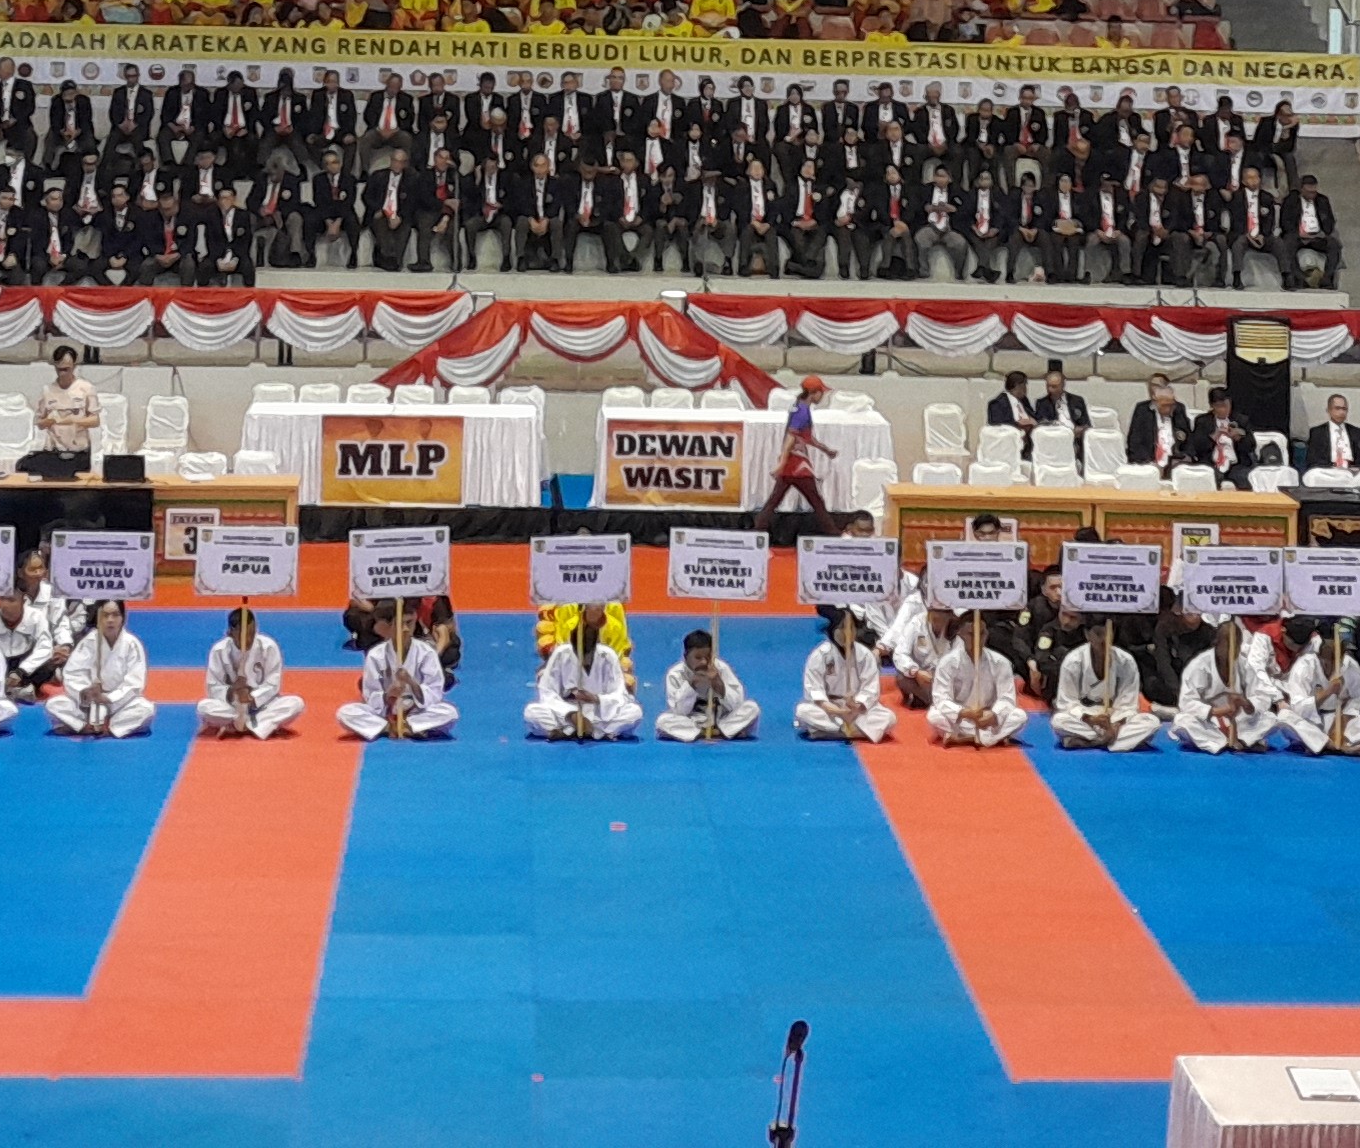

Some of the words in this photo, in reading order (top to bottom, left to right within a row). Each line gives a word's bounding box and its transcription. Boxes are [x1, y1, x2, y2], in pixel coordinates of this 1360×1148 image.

[117, 34, 248, 53] KARATEKA
[258, 36, 327, 54] YANG
[339, 38, 441, 56] RENDAH
[452, 40, 508, 59] HATI
[518, 42, 628, 61] BERBUDI
[639, 45, 731, 67] LUHUR,
[741, 47, 791, 66] DAN
[802, 49, 966, 69] BERPRESTASI
[976, 54, 1062, 73] UNTUK
[1072, 57, 1173, 75] BANGSA
[1183, 59, 1234, 77] DAN
[615, 433, 735, 459] DEWAN
[337, 443, 446, 476] MLP
[623, 465, 727, 491] WASIT
[183, 526, 198, 555] 3
[69, 566, 135, 579] MALUKU
[221, 562, 272, 576] PAPUA
[367, 563, 432, 577] SULAWESI
[684, 564, 753, 578] SULAWESI
[371, 575, 429, 588] SELATAN
[561, 571, 599, 584] RIAU
[689, 576, 745, 589] TENGAH
[816, 570, 883, 583] SULAWESI
[76, 579, 126, 591] UTARA
[943, 579, 1016, 591] SUMATERA
[1078, 581, 1146, 593] SUMATERA
[1196, 584, 1269, 595] SUMATERA
[1317, 584, 1353, 596] ASKI
[1210, 595, 1255, 606] UTARA
